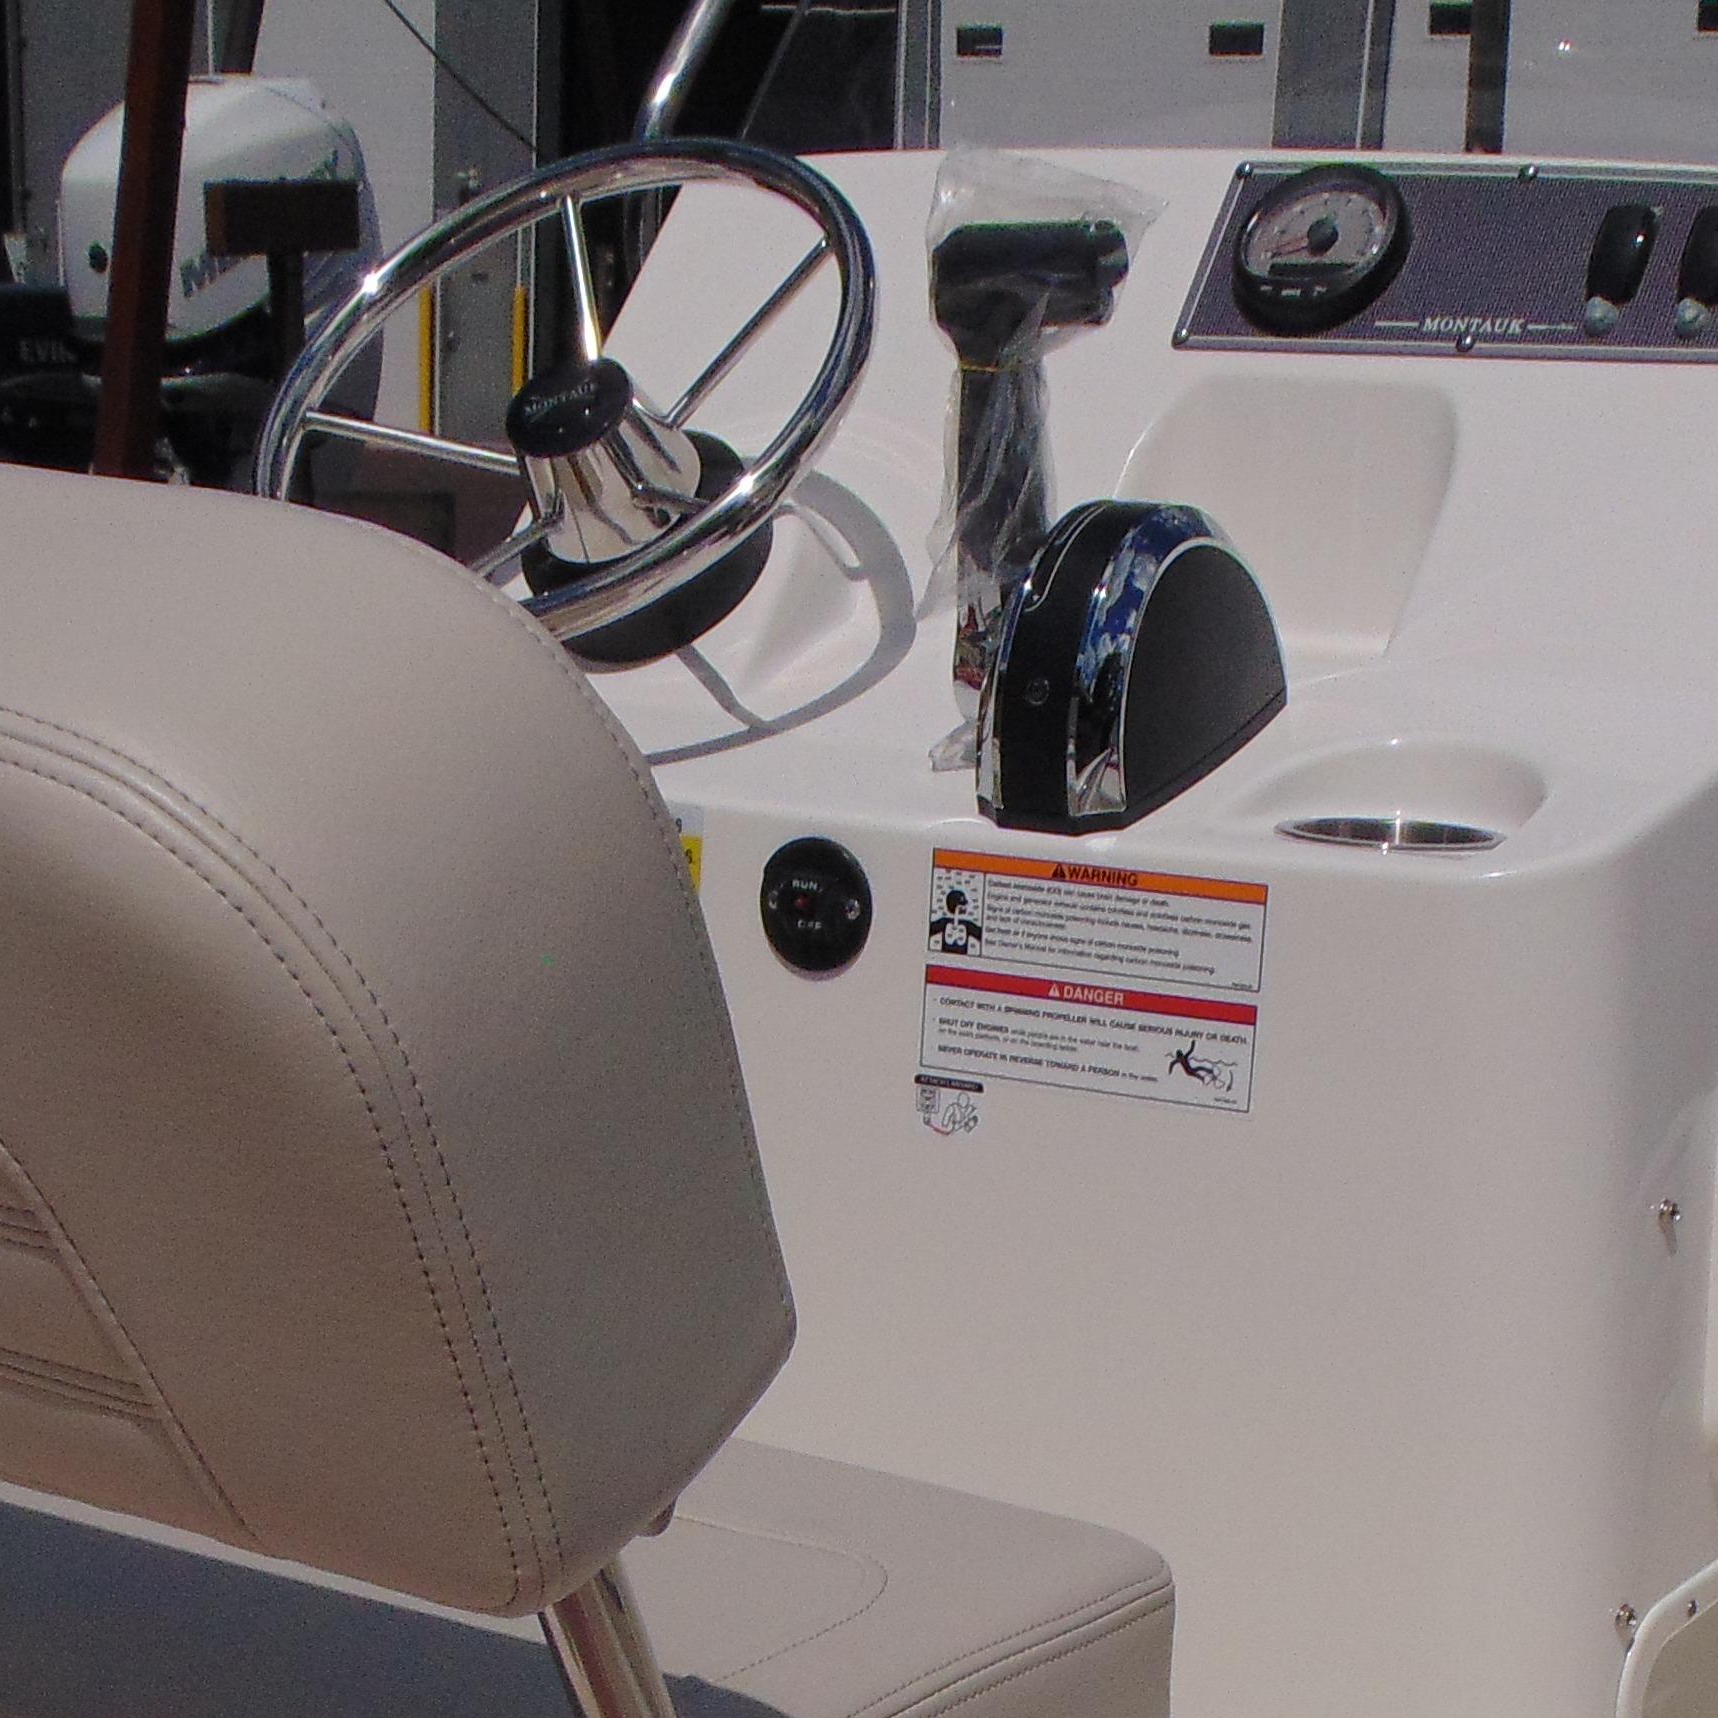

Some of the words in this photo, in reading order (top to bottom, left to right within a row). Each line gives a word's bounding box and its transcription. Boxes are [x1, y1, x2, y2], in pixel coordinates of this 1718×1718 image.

[1422, 316, 1525, 334] MONTAUK
[792, 879, 818, 891] RUN
[1067, 865, 1138, 886] WARNING
[1063, 984, 1124, 1005] DANGER
[938, 1016, 958, 1026] SHUT
[960, 1019, 973, 1029] OFF
[939, 997, 973, 1008] CONTACT
[976, 1002, 995, 1011] WITH
[997, 1004, 1001, 1012] A
[1042, 1010, 1086, 1023] PROPELLER
[1109, 1019, 1135, 1030] CAUSE
[1174, 1027, 1202, 1039] INJURY
[1205, 1031, 1217, 1041] OR
[938, 1044, 961, 1055] NEVER
[963, 1048, 998, 1060] OPERATE
[1000, 1053, 1007, 1061] IN
[1009, 1054, 1042, 1066] REVERSE
[1044, 1060, 1077, 1071] TOWARD
[1088, 1066, 1120, 1077] PERSON
